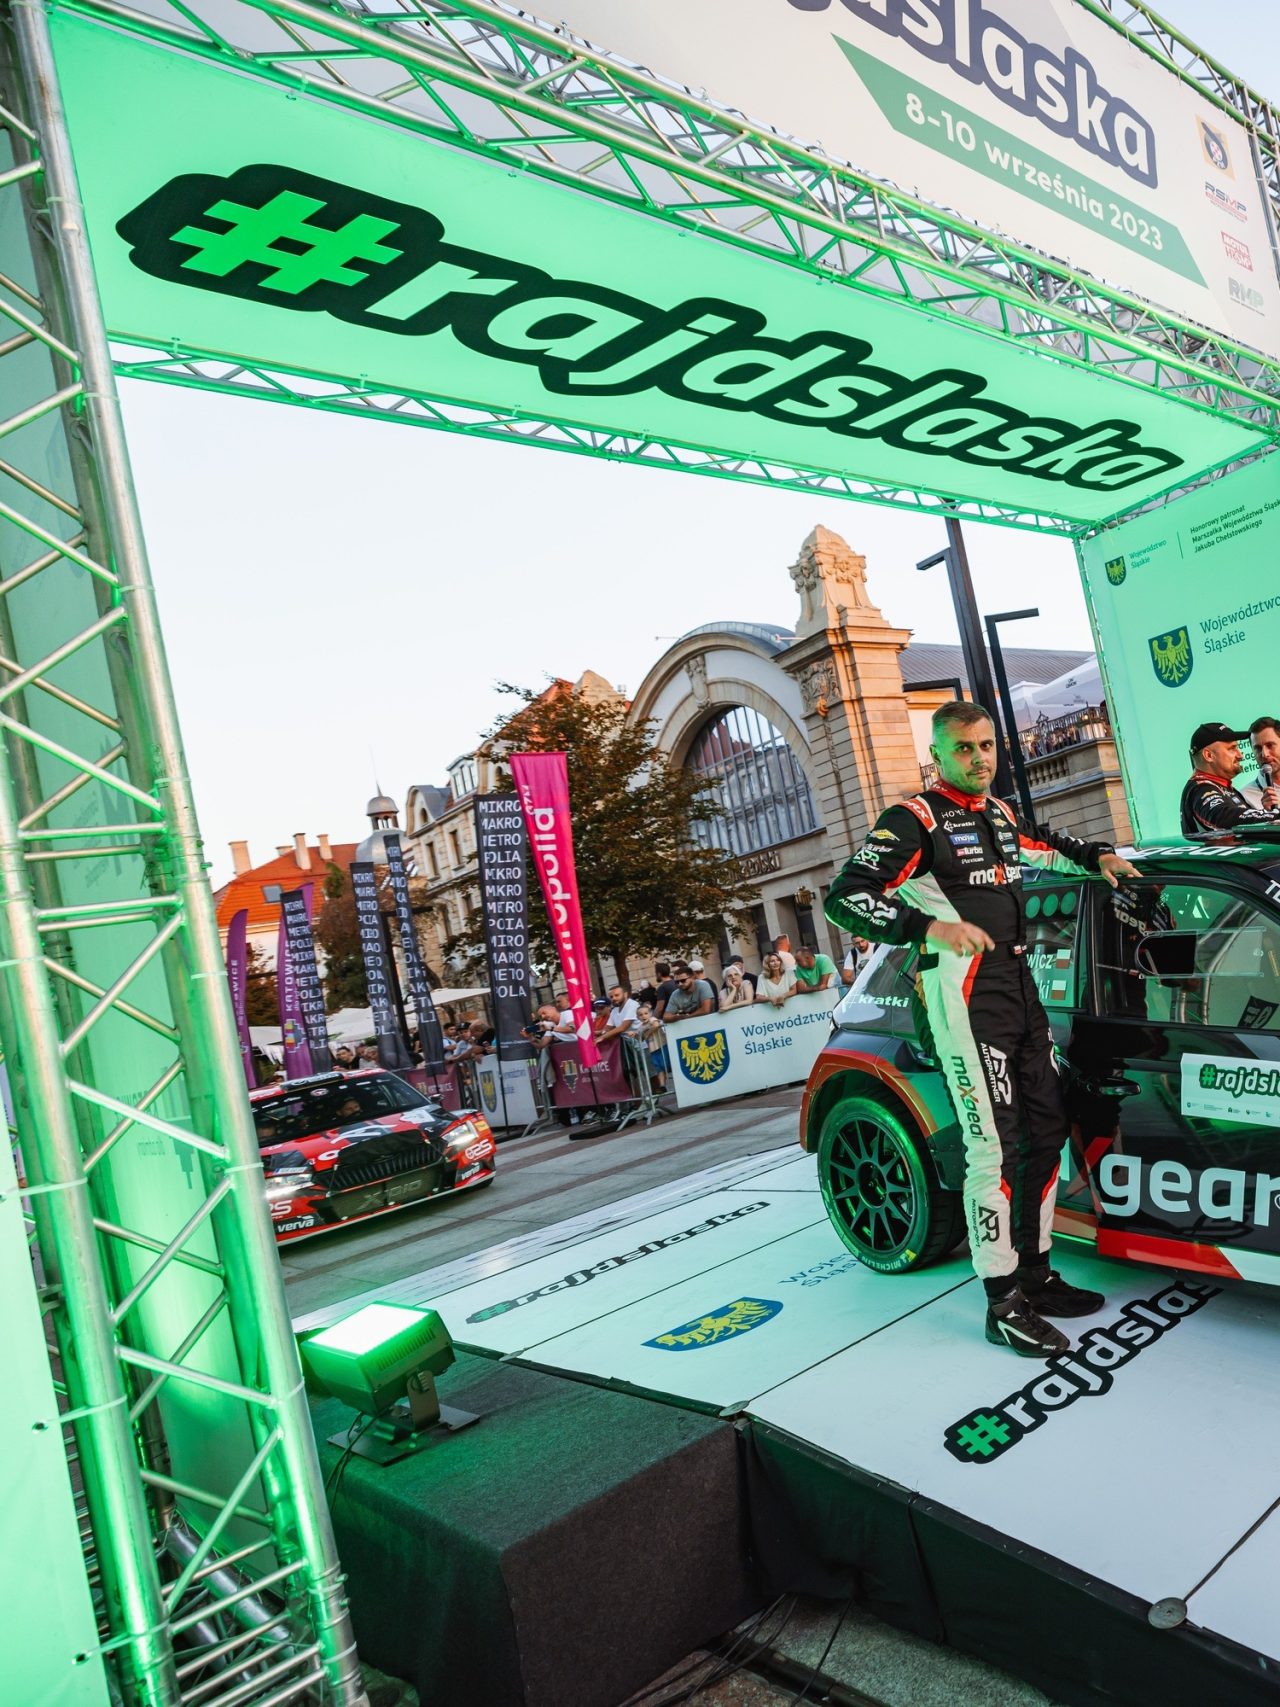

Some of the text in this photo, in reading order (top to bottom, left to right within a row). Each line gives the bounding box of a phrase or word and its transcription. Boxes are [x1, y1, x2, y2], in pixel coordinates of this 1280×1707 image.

[905, 92, 976, 152] 8-10
[984, 140, 1104, 221] września
[1108, 203, 1164, 252] 2023
[150, 180, 1178, 489] #rajdslaska
[1190, 505, 1246, 534] Honorowy patronat
[1129, 539, 1168, 560] Województwo
[1204, 629, 1246, 655] Śląskie
[479, 800, 522, 814] MIKRO
[859, 994, 909, 1008] kratki
[741, 1009, 833, 1038] Województwo
[744, 1035, 793, 1055] Śląskie
[979, 1042, 1000, 1103] AUTOPARTNER
[278, 1216, 315, 1233] verva
